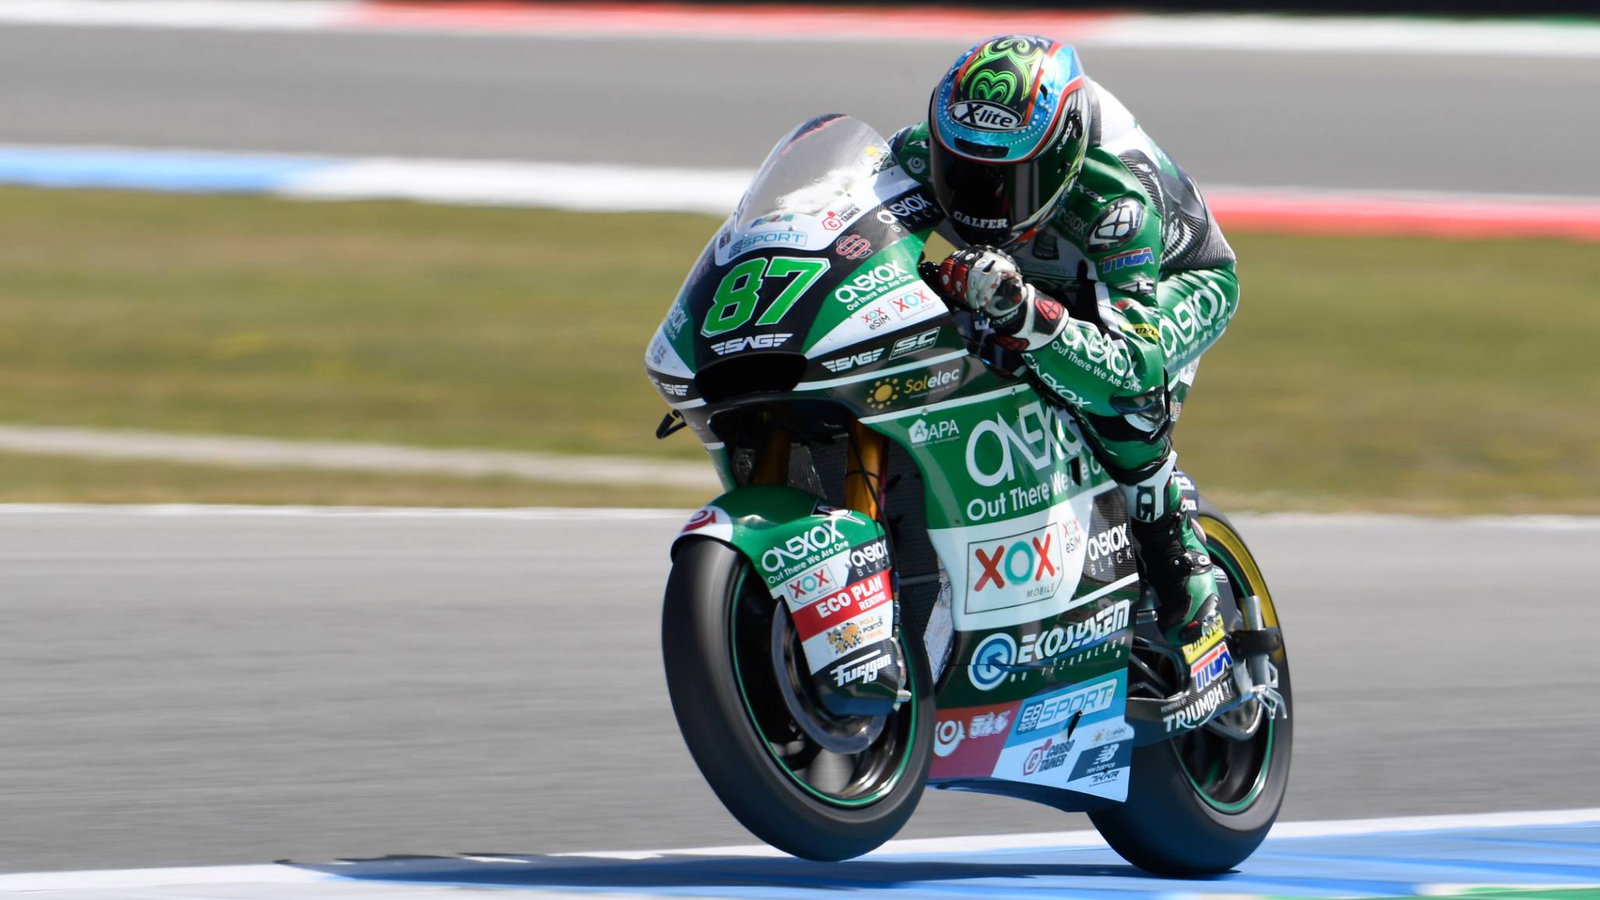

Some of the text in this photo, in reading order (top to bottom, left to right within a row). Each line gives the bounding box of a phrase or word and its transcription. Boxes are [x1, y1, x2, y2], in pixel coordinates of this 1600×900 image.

[962, 102, 1013, 128] X-lite
[953, 211, 1009, 229] GALFER
[700, 256, 831, 337] 87
[835, 260, 909, 303] ONEXOX
[904, 369, 960, 394] Solelec
[1051, 341, 1067, 356] Out
[1068, 350, 1092, 371] There
[1093, 366, 1107, 379] We
[1107, 374, 1121, 387] Are
[927, 419, 960, 441] APA
[967, 489, 1006, 521] Out
[1010, 482, 1050, 511] There
[1050, 470, 1069, 496] We
[762, 519, 845, 572] ONEXOX
[1087, 523, 1130, 561] ONEXOX
[768, 572, 784, 584] Out
[784, 561, 807, 577] There
[807, 554, 820, 565] We
[974, 533, 1055, 592] XOX
[1090, 547, 1133, 576] BLACK
[789, 569, 829, 599] XOX
[816, 577, 884, 619] ECO PLAN
[1026, 583, 1055, 598] MOBILE
[1042, 685, 1114, 721] SPORT
[1163, 684, 1224, 732] TRIUMPH
